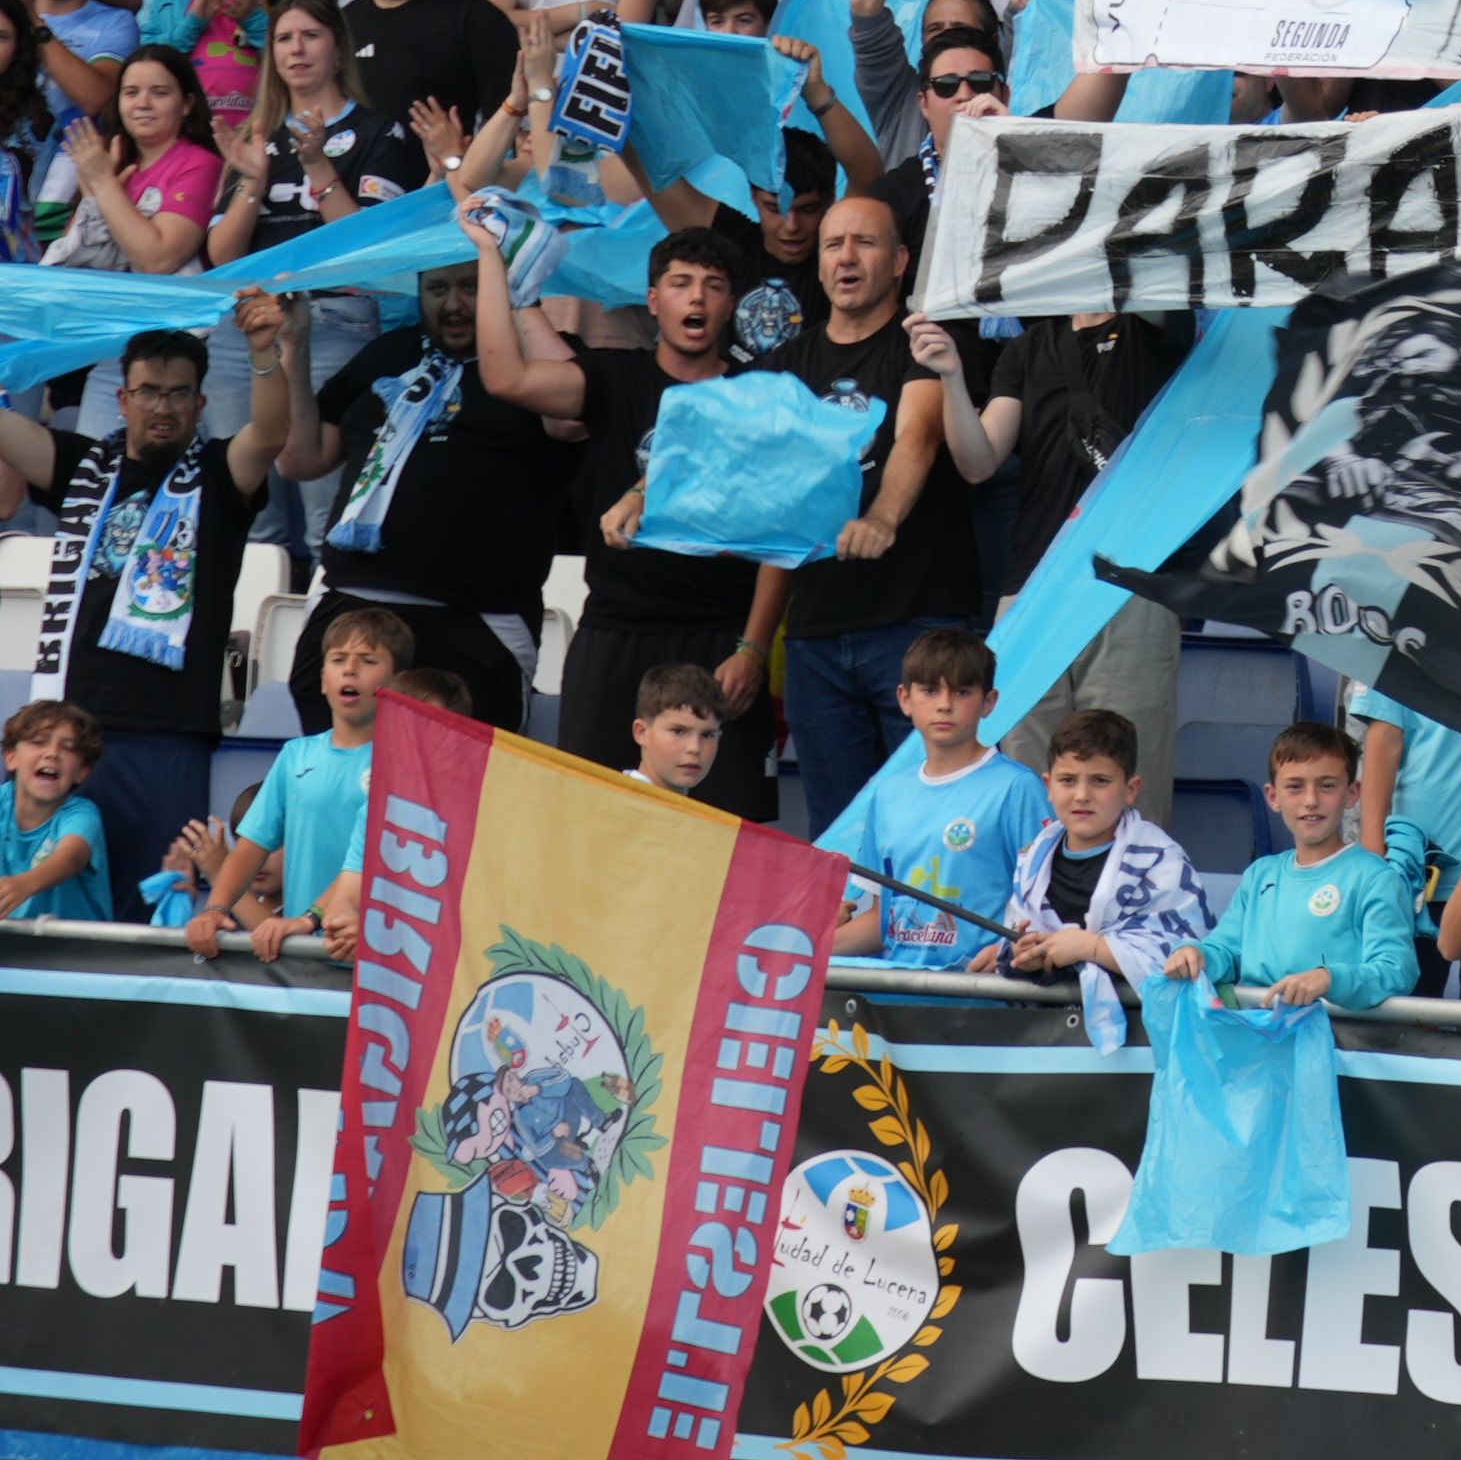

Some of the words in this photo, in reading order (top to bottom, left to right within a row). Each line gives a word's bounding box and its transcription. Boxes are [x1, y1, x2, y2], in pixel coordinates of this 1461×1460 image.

[1271, 19, 1351, 49] SEGUNDA
[975, 123, 1458, 310] PARA
[832, 1249, 854, 1278] de
[862, 1259, 929, 1307] Lucena
